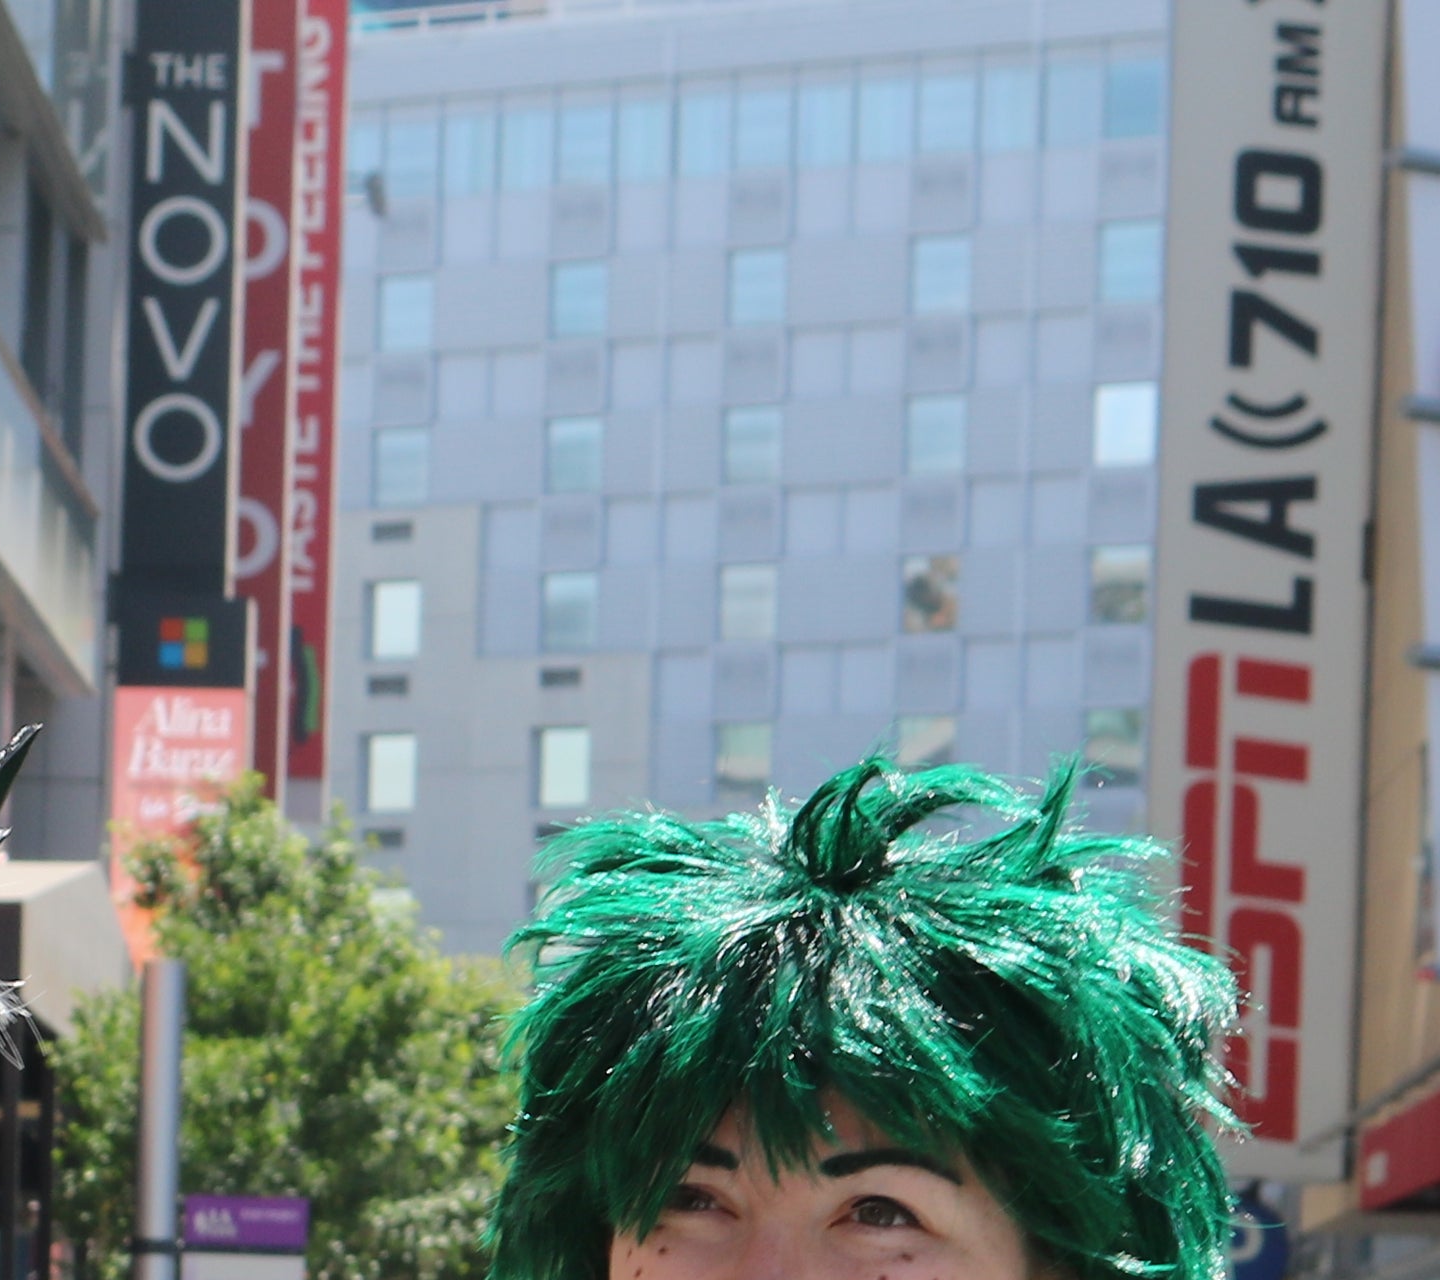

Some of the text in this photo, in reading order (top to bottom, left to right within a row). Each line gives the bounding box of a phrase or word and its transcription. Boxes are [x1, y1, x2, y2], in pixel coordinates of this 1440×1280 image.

[150, 51, 228, 91] THE
[1273, 22, 1323, 128] AM
[133, 98, 228, 483] NOVO
[1229, 146, 1324, 368] 710
[1189, 476, 1319, 636] LA
